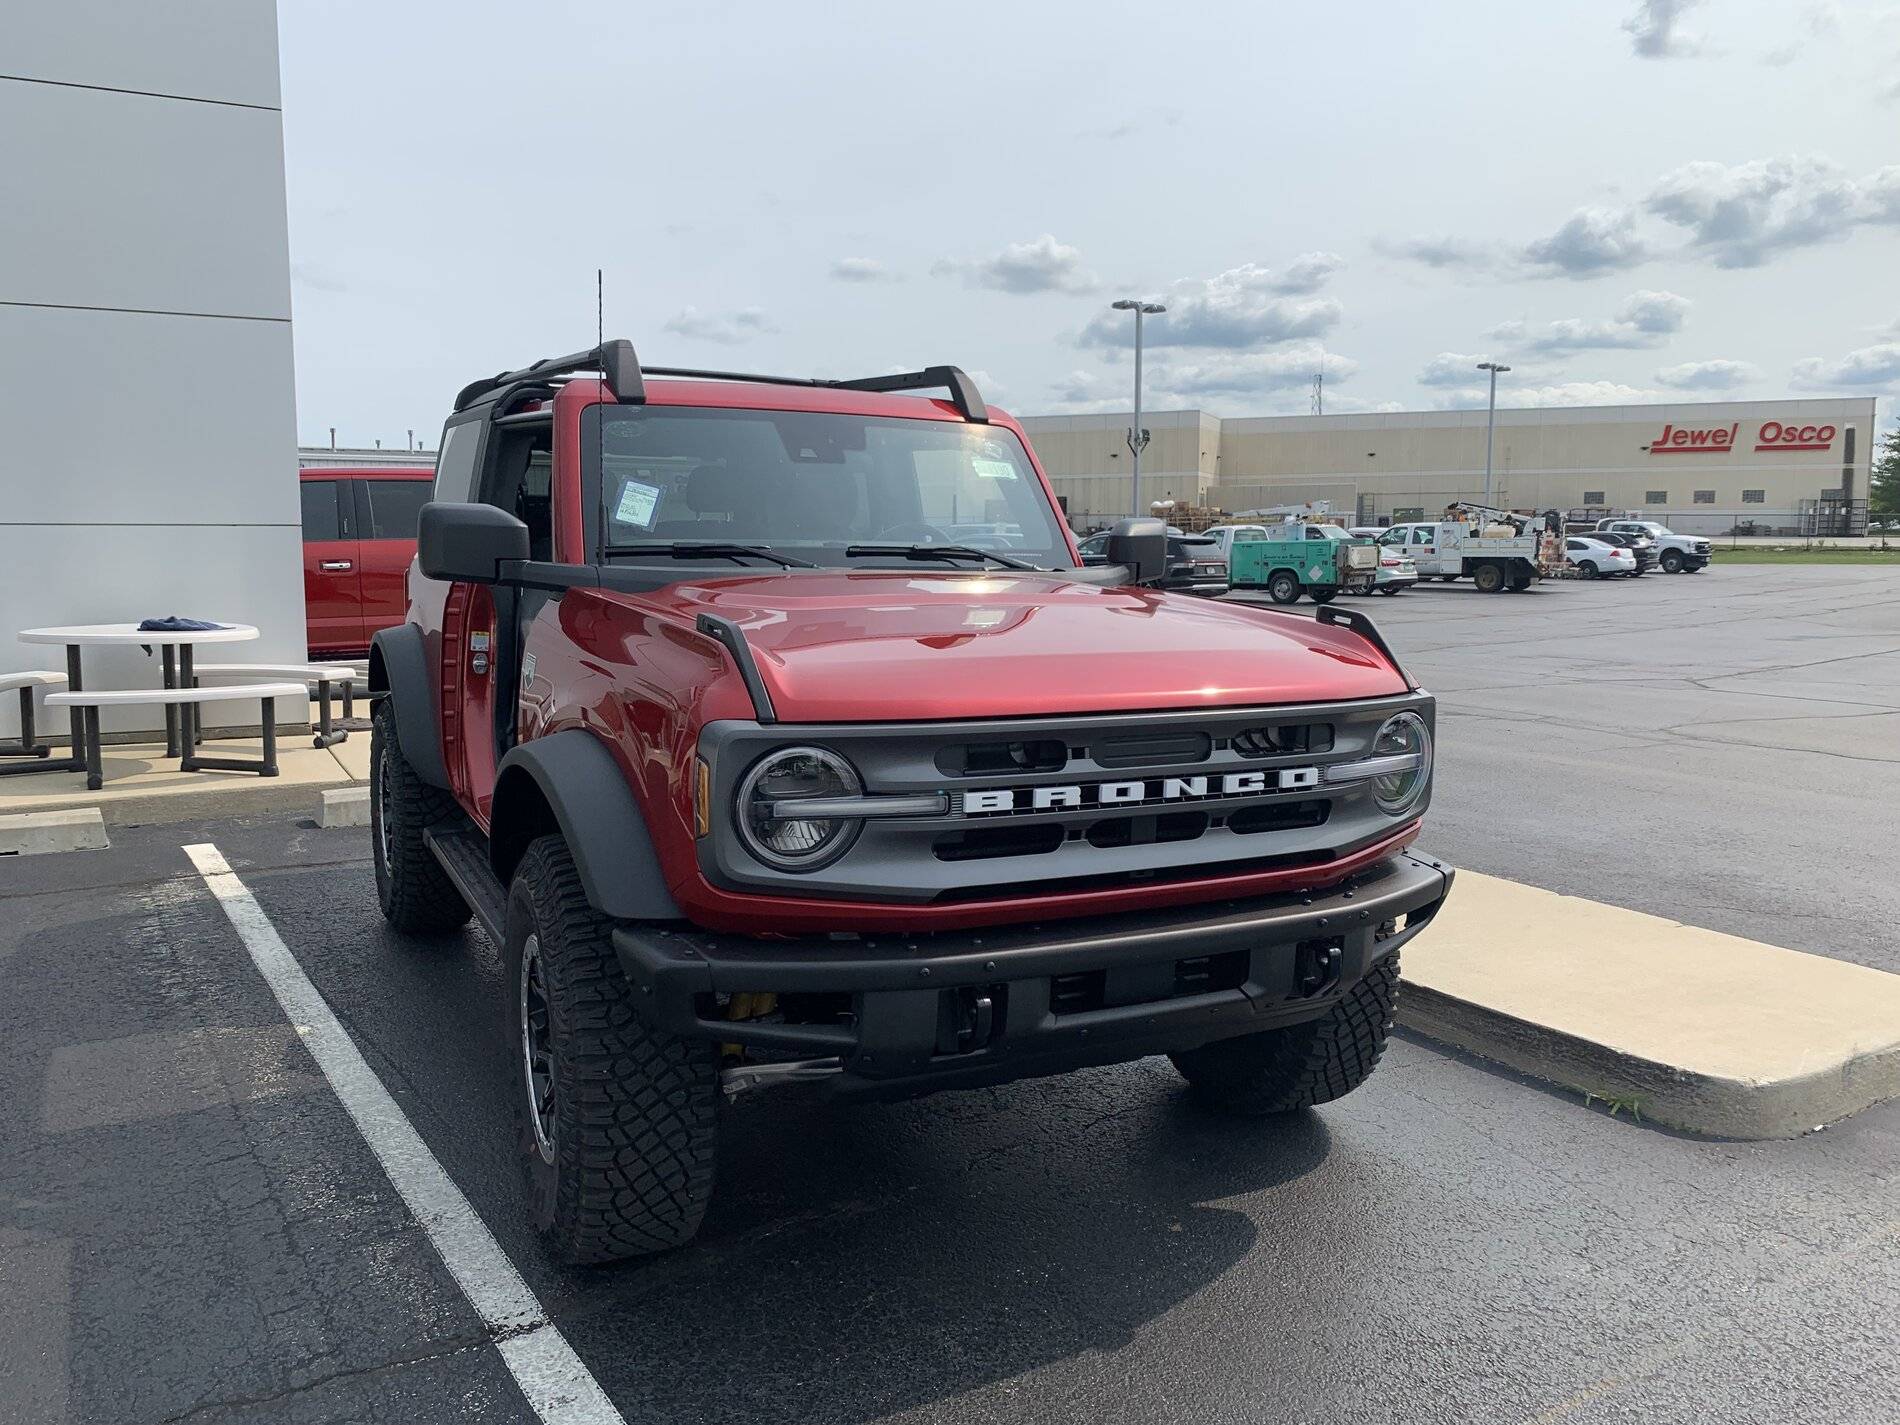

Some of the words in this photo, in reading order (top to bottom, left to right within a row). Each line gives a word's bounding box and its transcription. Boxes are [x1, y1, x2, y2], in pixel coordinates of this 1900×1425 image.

[1652, 422, 1739, 446] Jewel
[1758, 421, 1836, 443] Osco
[962, 767, 1319, 814] BRONCO
